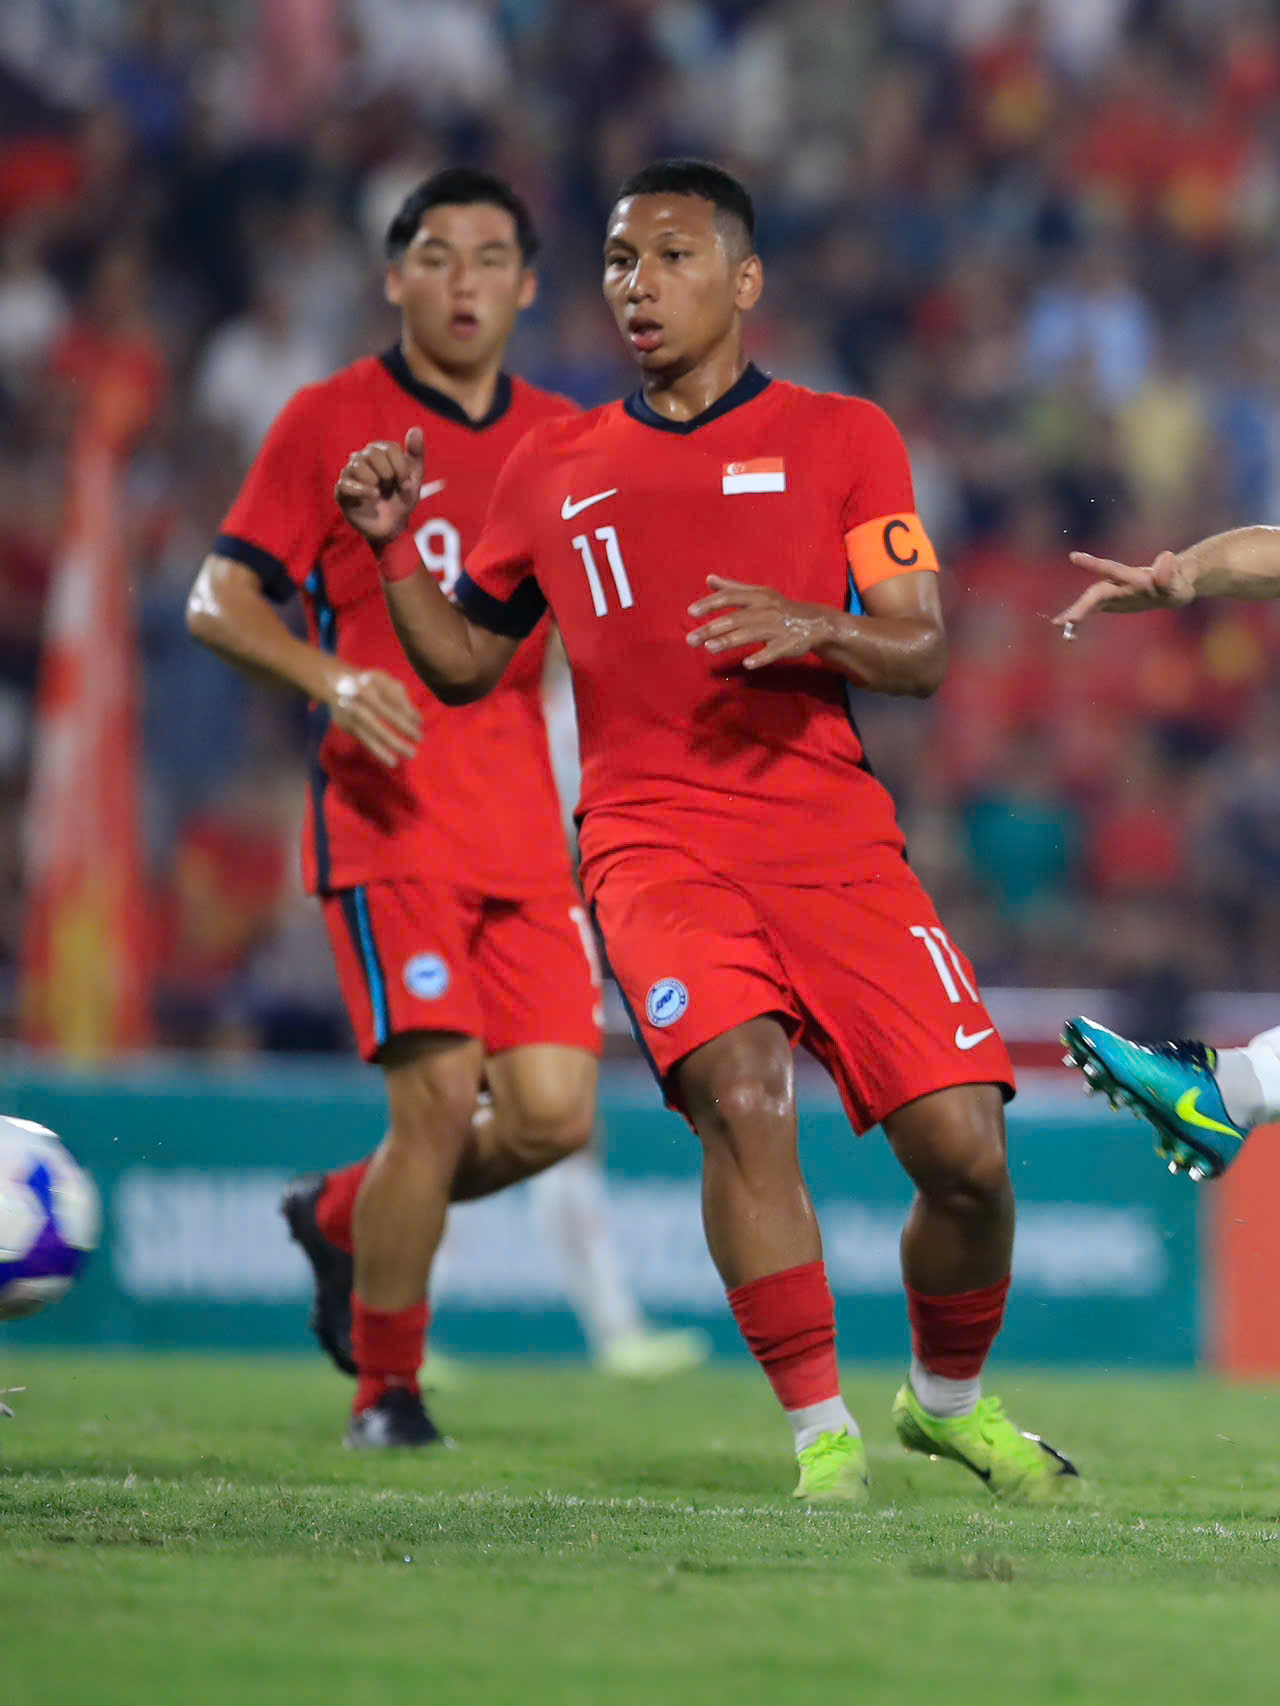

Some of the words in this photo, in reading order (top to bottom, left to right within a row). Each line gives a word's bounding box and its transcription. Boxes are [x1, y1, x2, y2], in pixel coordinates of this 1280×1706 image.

[414, 518, 461, 603] 9
[571, 525, 634, 617] 11
[884, 519, 919, 567] C
[908, 925, 979, 1004] 11
